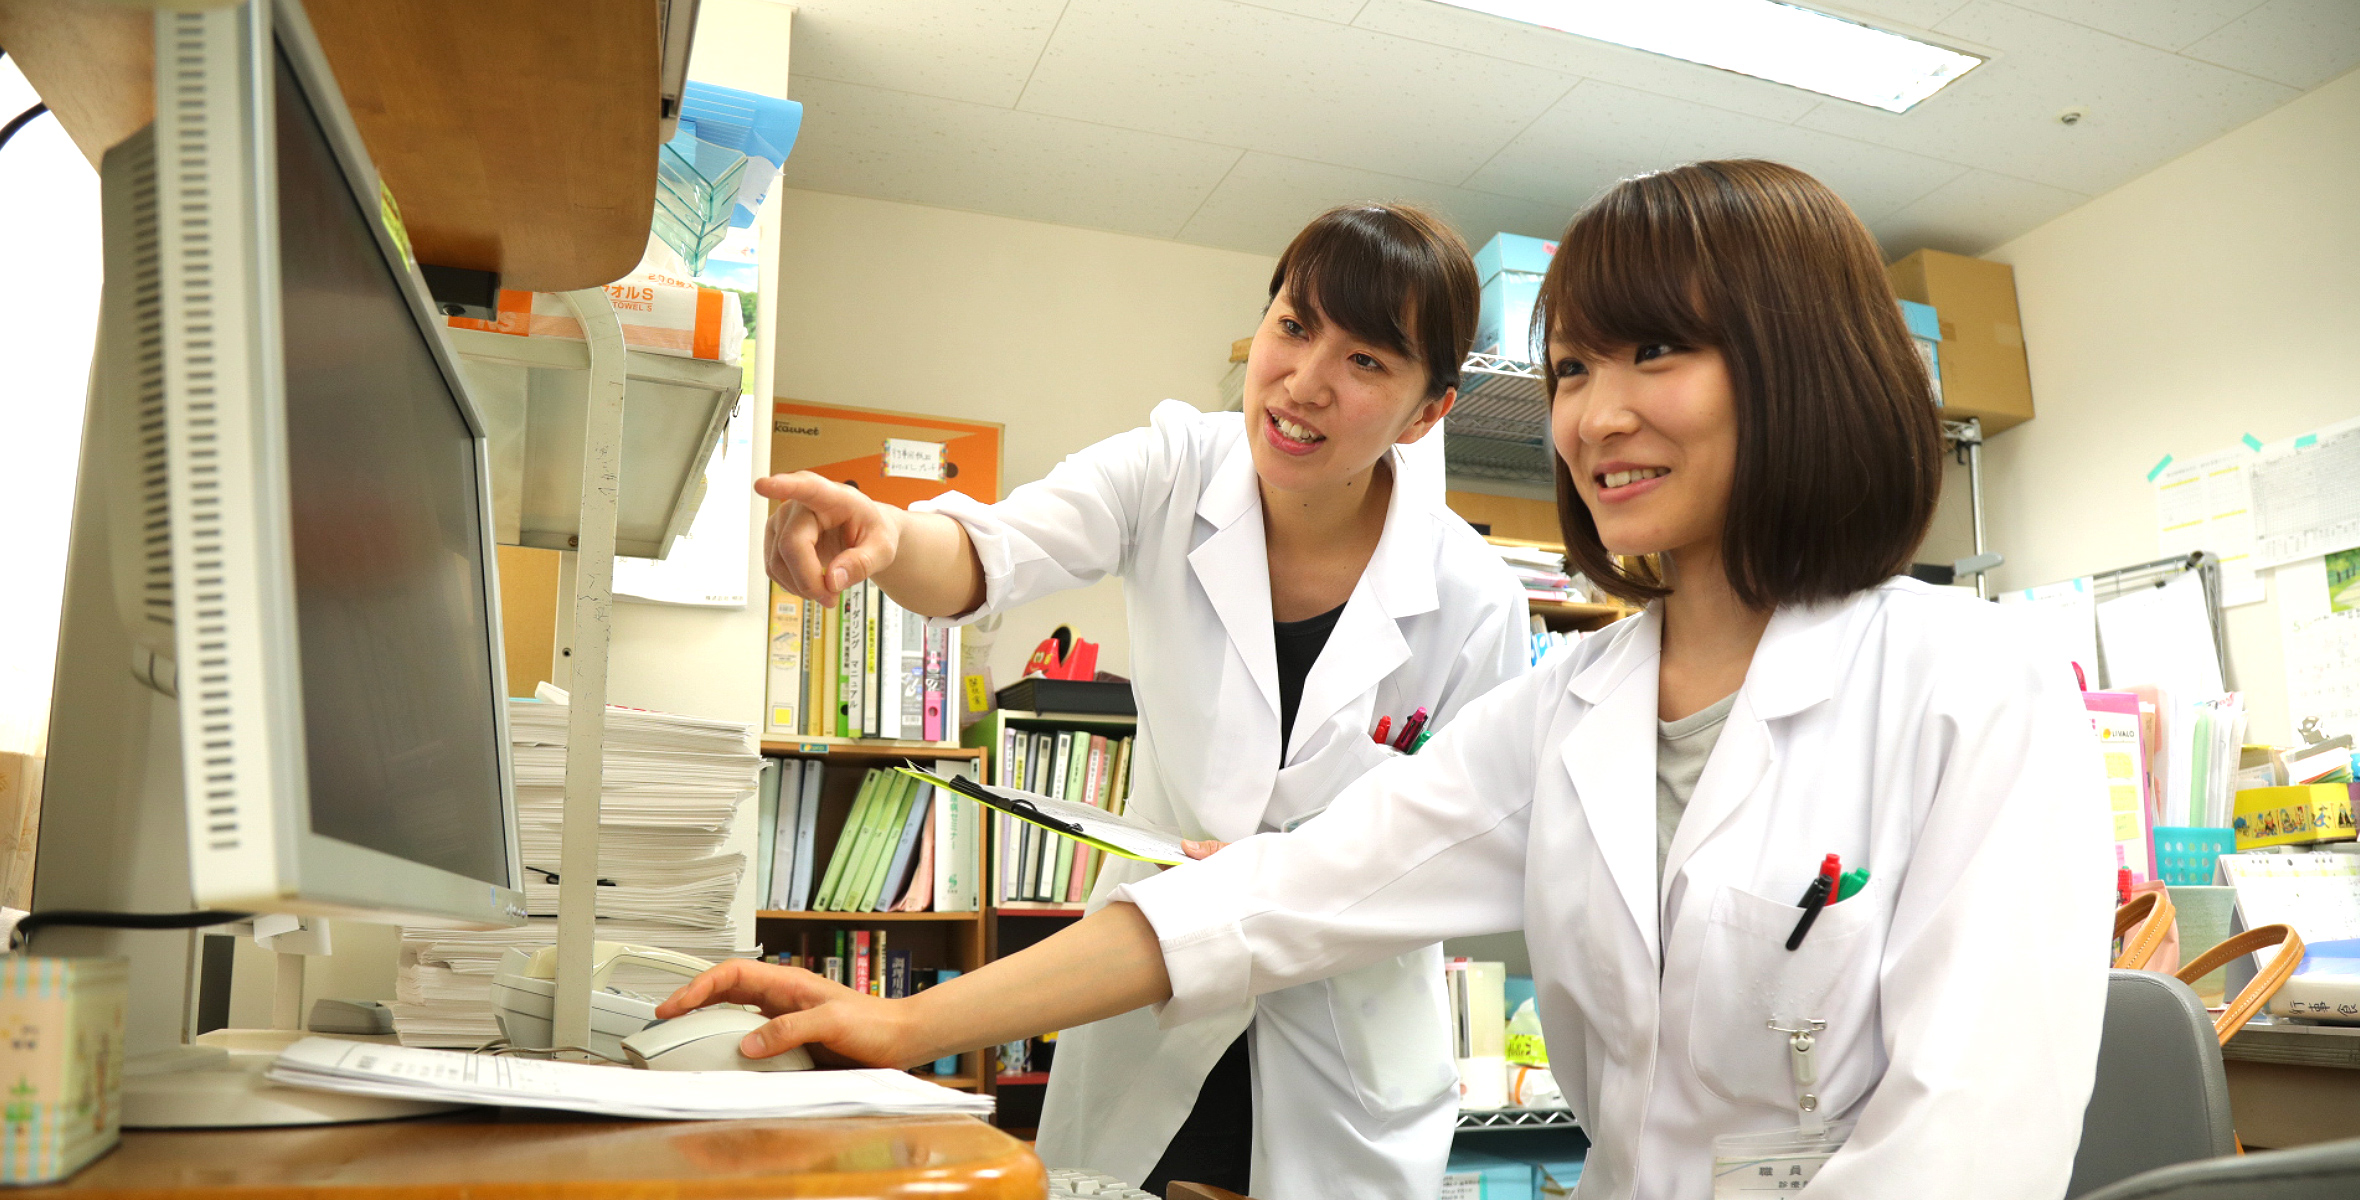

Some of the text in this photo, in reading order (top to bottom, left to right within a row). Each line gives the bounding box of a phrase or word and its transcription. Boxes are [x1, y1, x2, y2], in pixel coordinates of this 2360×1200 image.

[612, 301, 643, 311] TOWEL
[849, 591, 861, 709] オーダリング マニュアル
[2112, 730, 2135, 738] LIVALO
[1759, 1164, 1823, 1176] 職員
